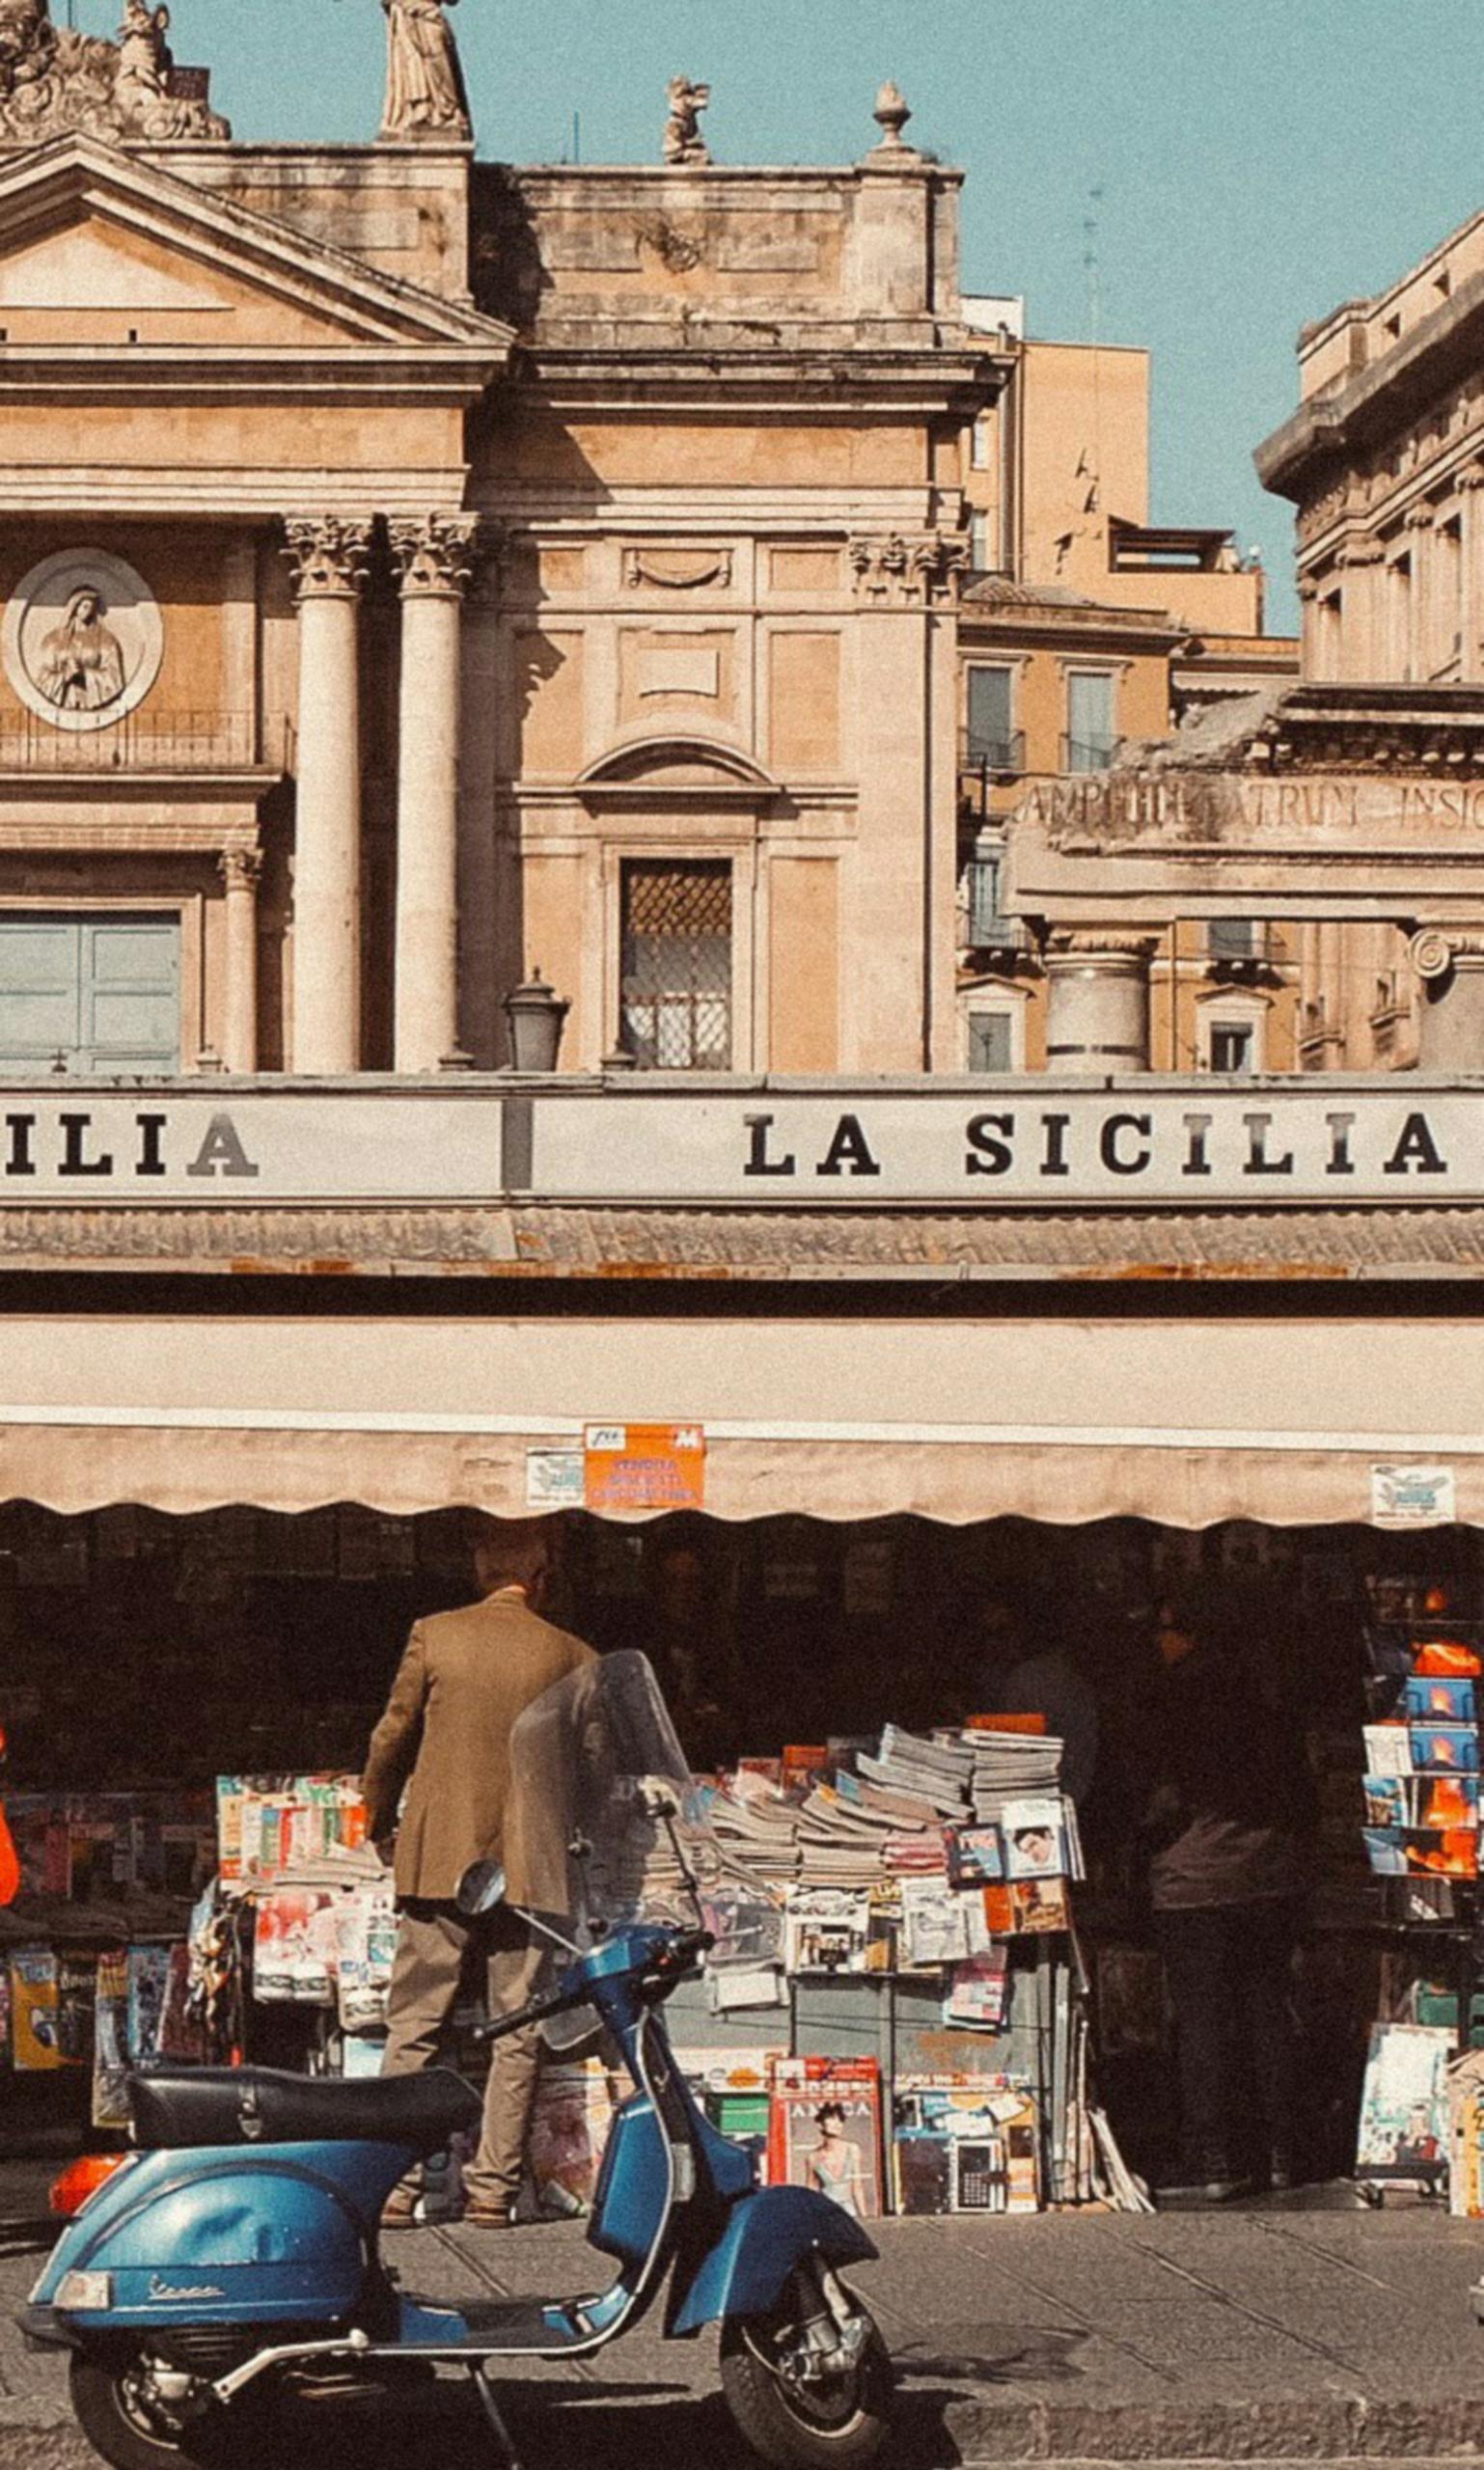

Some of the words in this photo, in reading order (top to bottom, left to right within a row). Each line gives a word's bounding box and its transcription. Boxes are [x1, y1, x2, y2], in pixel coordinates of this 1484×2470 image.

[5, 1113, 260, 1176] ILIA
[743, 1113, 880, 1176] LA
[965, 1112, 1447, 1176] SICILIA
